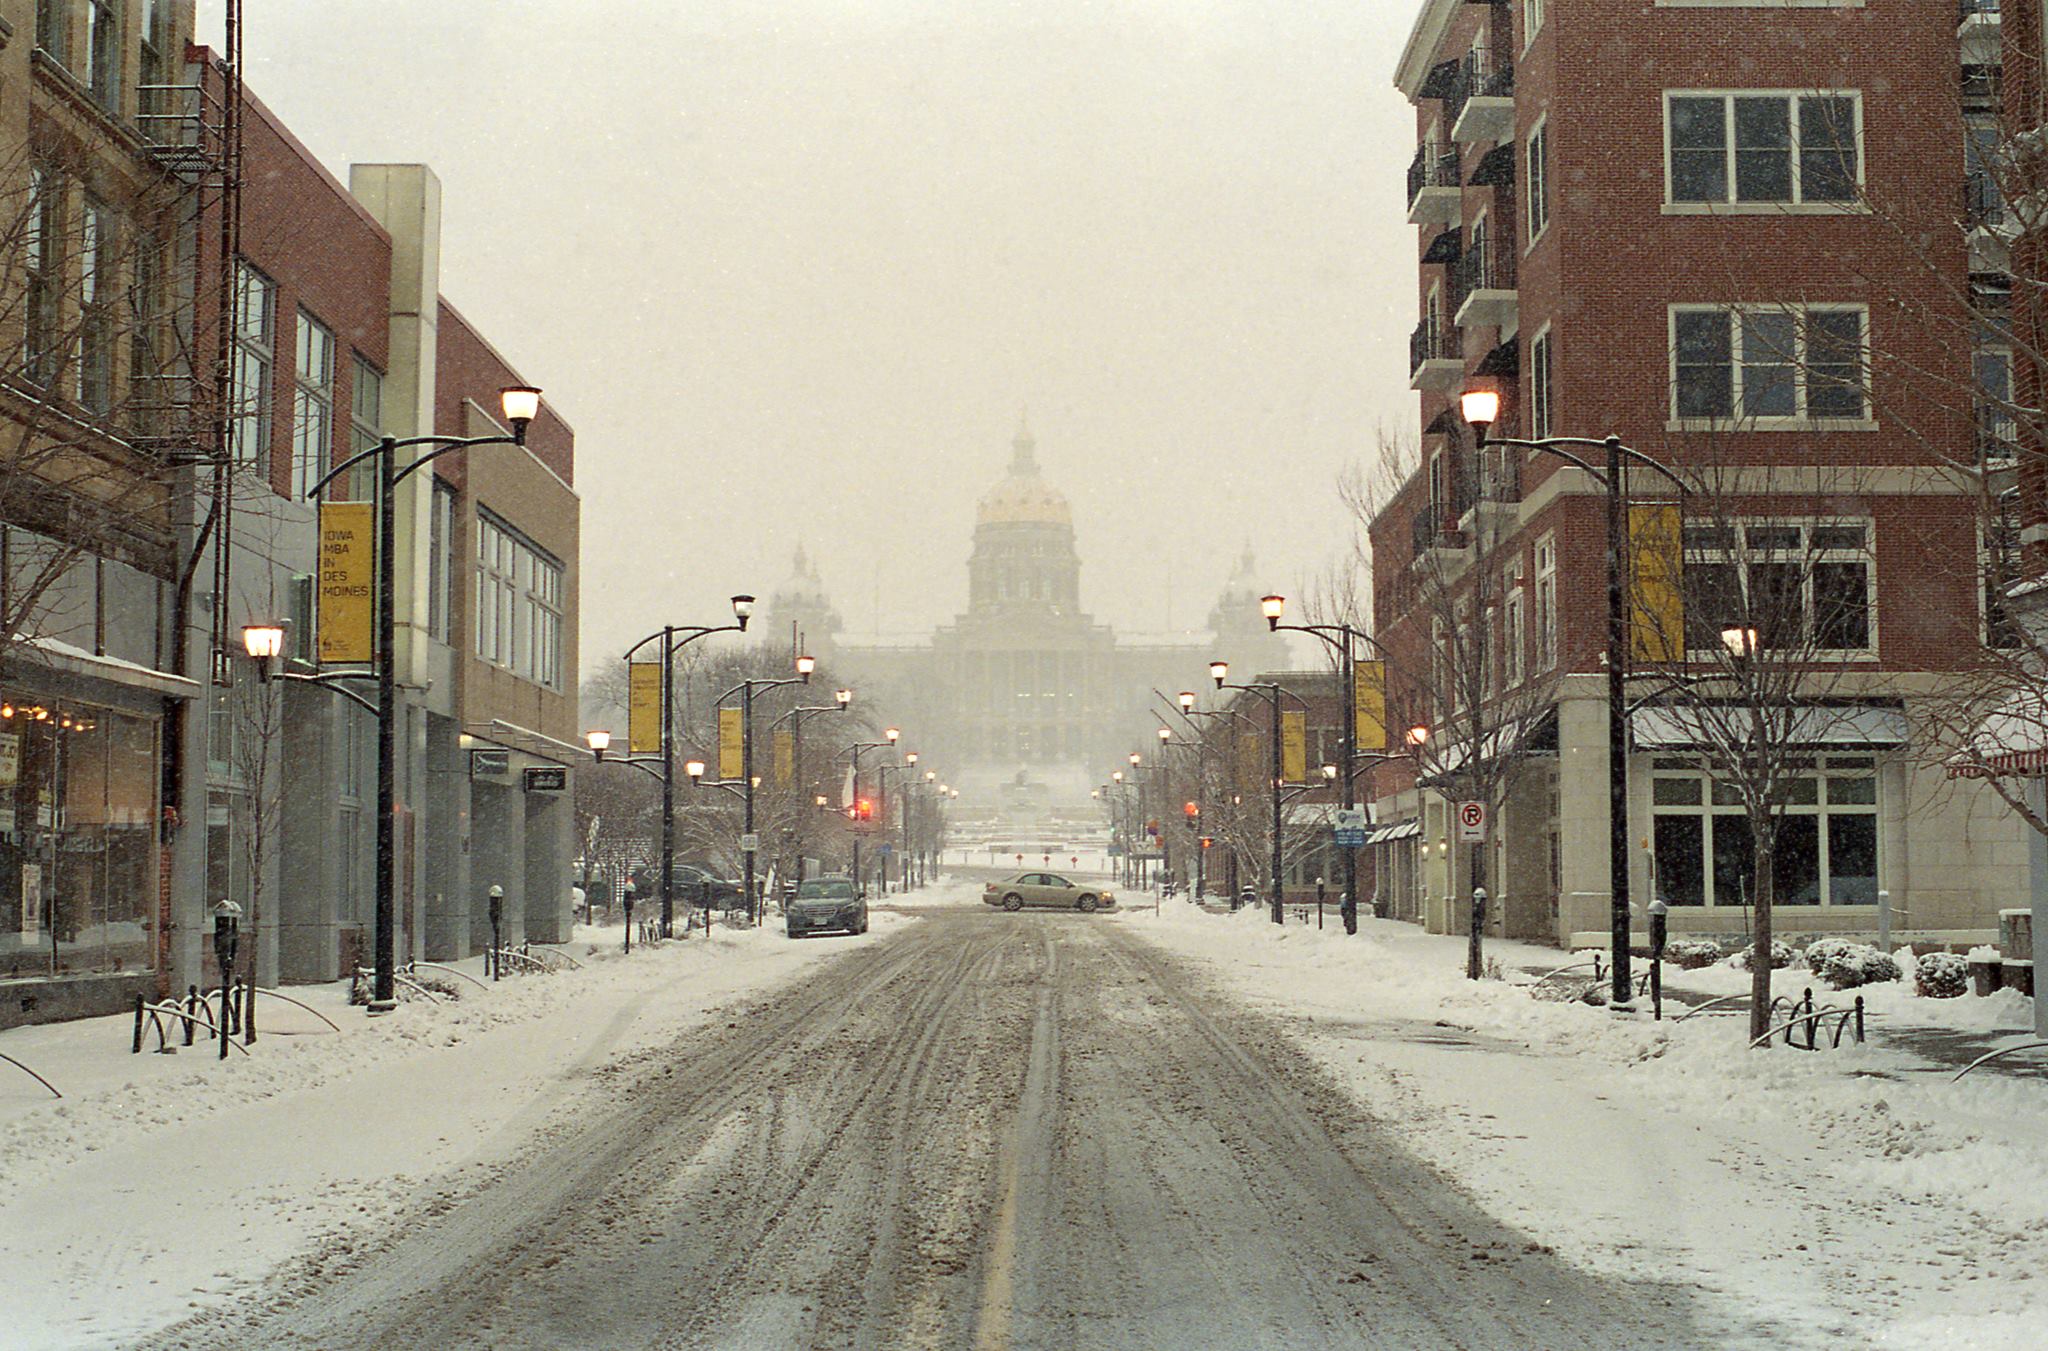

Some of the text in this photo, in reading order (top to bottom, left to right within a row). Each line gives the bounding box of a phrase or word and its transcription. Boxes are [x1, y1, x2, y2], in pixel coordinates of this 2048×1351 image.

[324, 531, 354, 541] IOWA
[324, 544, 349, 554] MBA
[324, 557, 335, 568] IN
[323, 571, 348, 581] DES
[323, 586, 369, 596] MOINES
